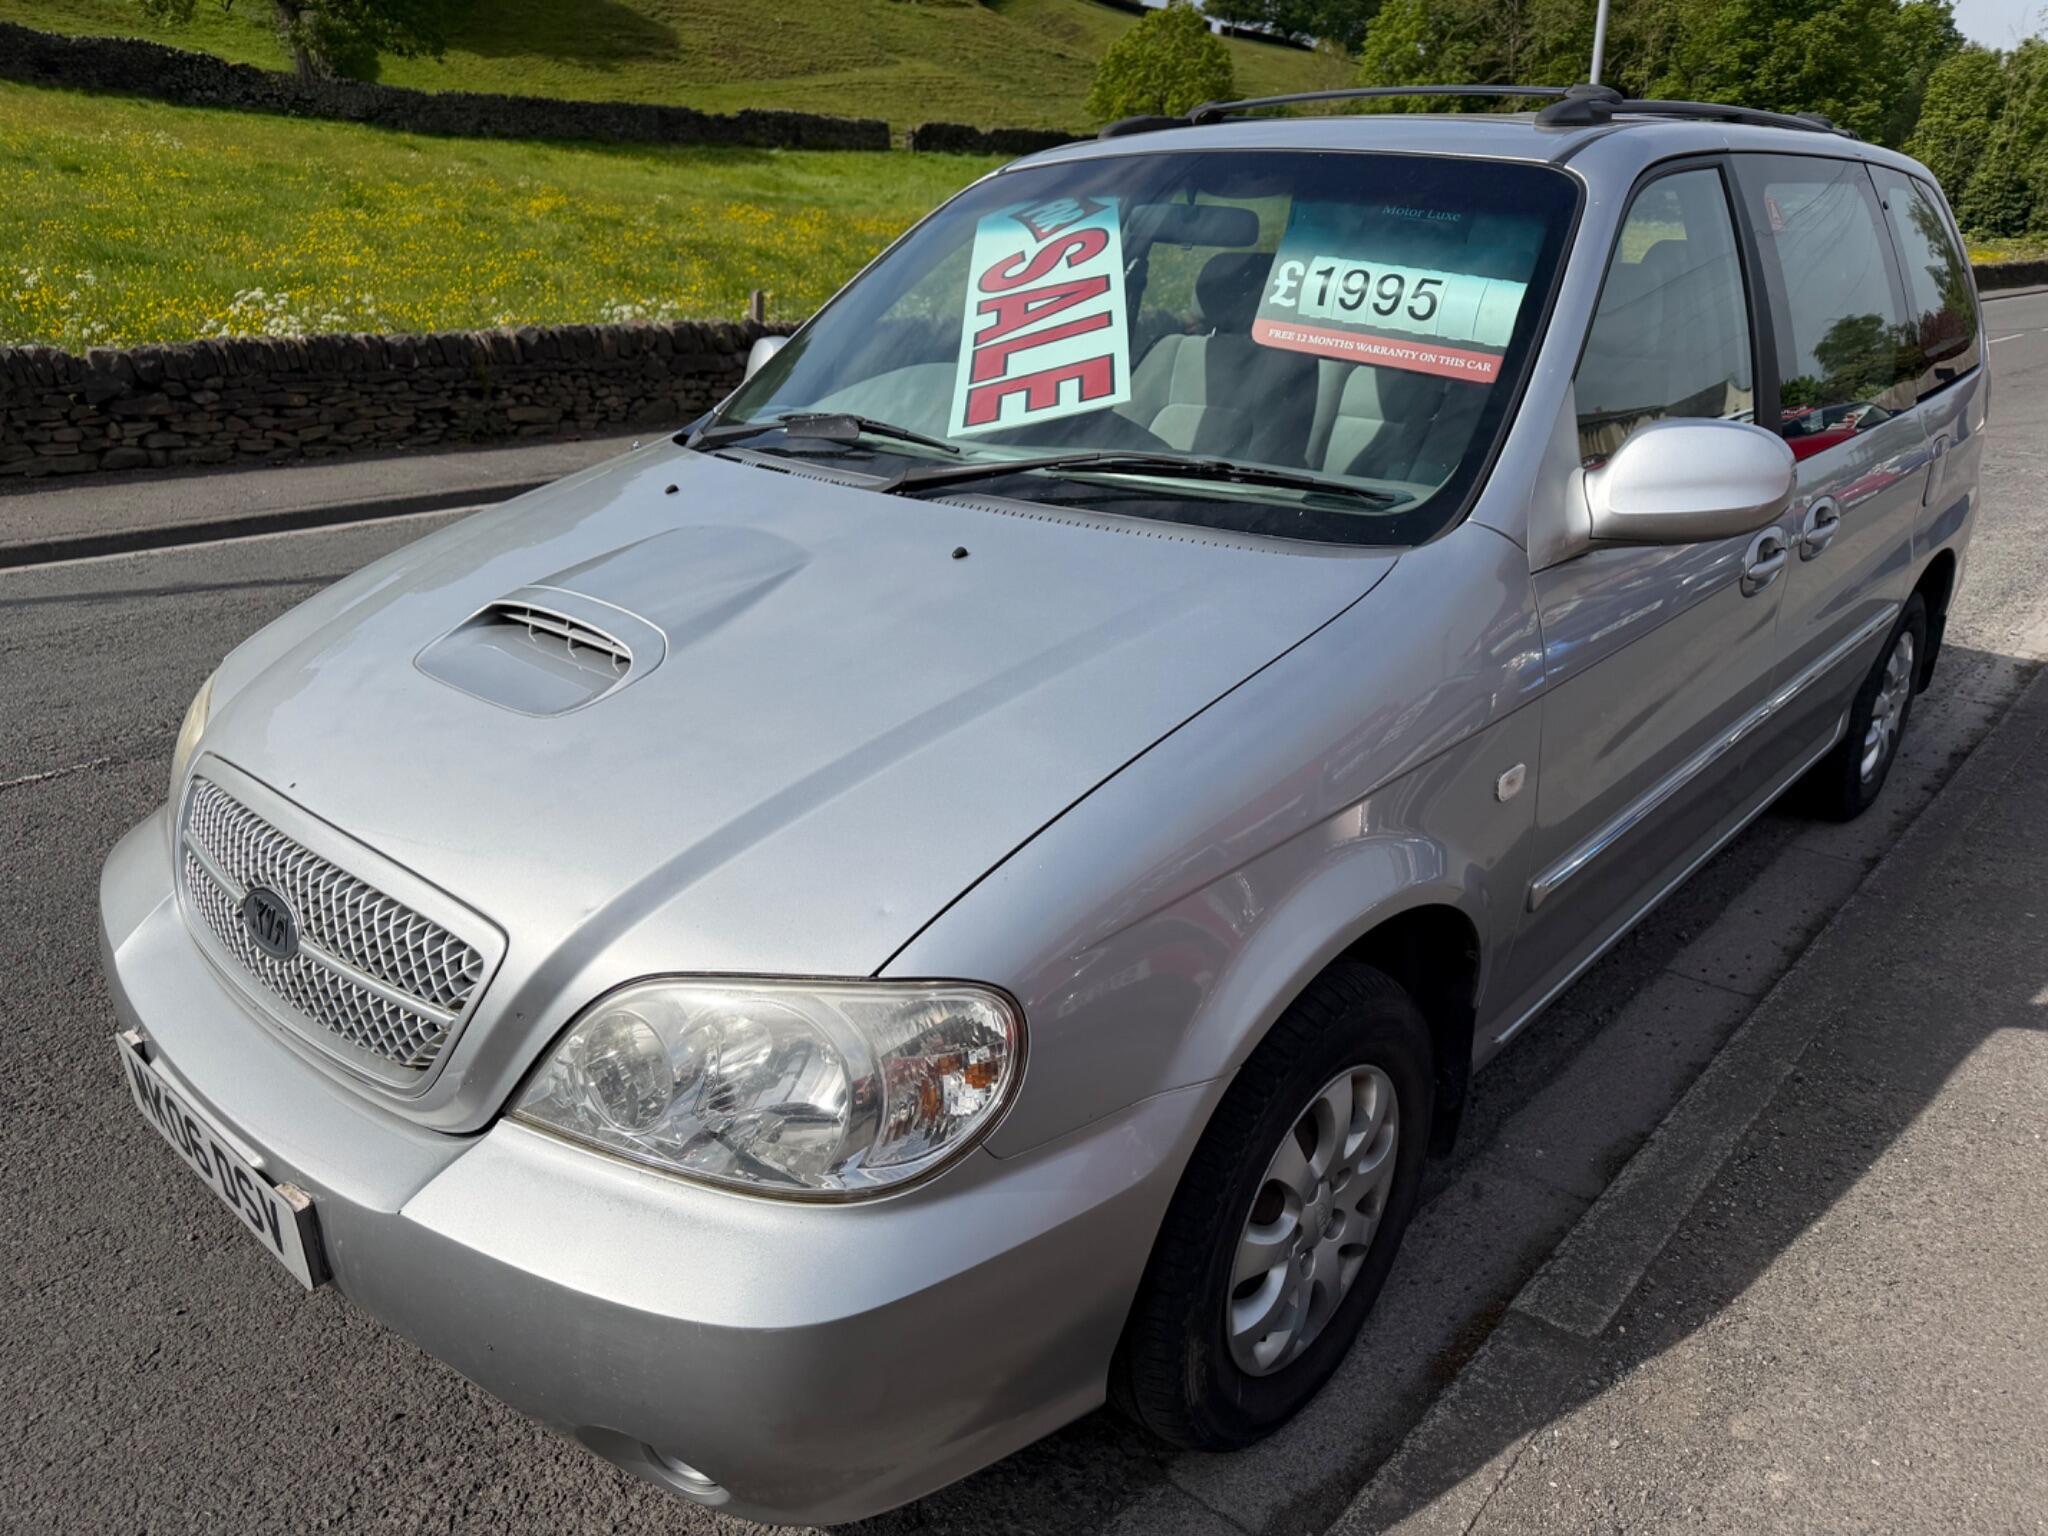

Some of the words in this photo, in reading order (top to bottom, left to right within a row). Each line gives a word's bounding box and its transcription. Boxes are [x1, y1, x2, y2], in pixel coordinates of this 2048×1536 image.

[1382, 204, 1424, 217] Motor
[1427, 209, 1461, 222] Luxe
[962, 227, 1117, 428] SALE
[1268, 328, 1296, 341] FREE
[1296, 332, 1308, 343] 12
[1307, 336, 1354, 350] MONTHS
[1355, 341, 1418, 360] WARRANTY
[1419, 352, 1437, 364] ON
[1438, 355, 1466, 368] THIS
[1466, 360, 1492, 372] CAR
[209, 1140, 285, 1256] DSV
